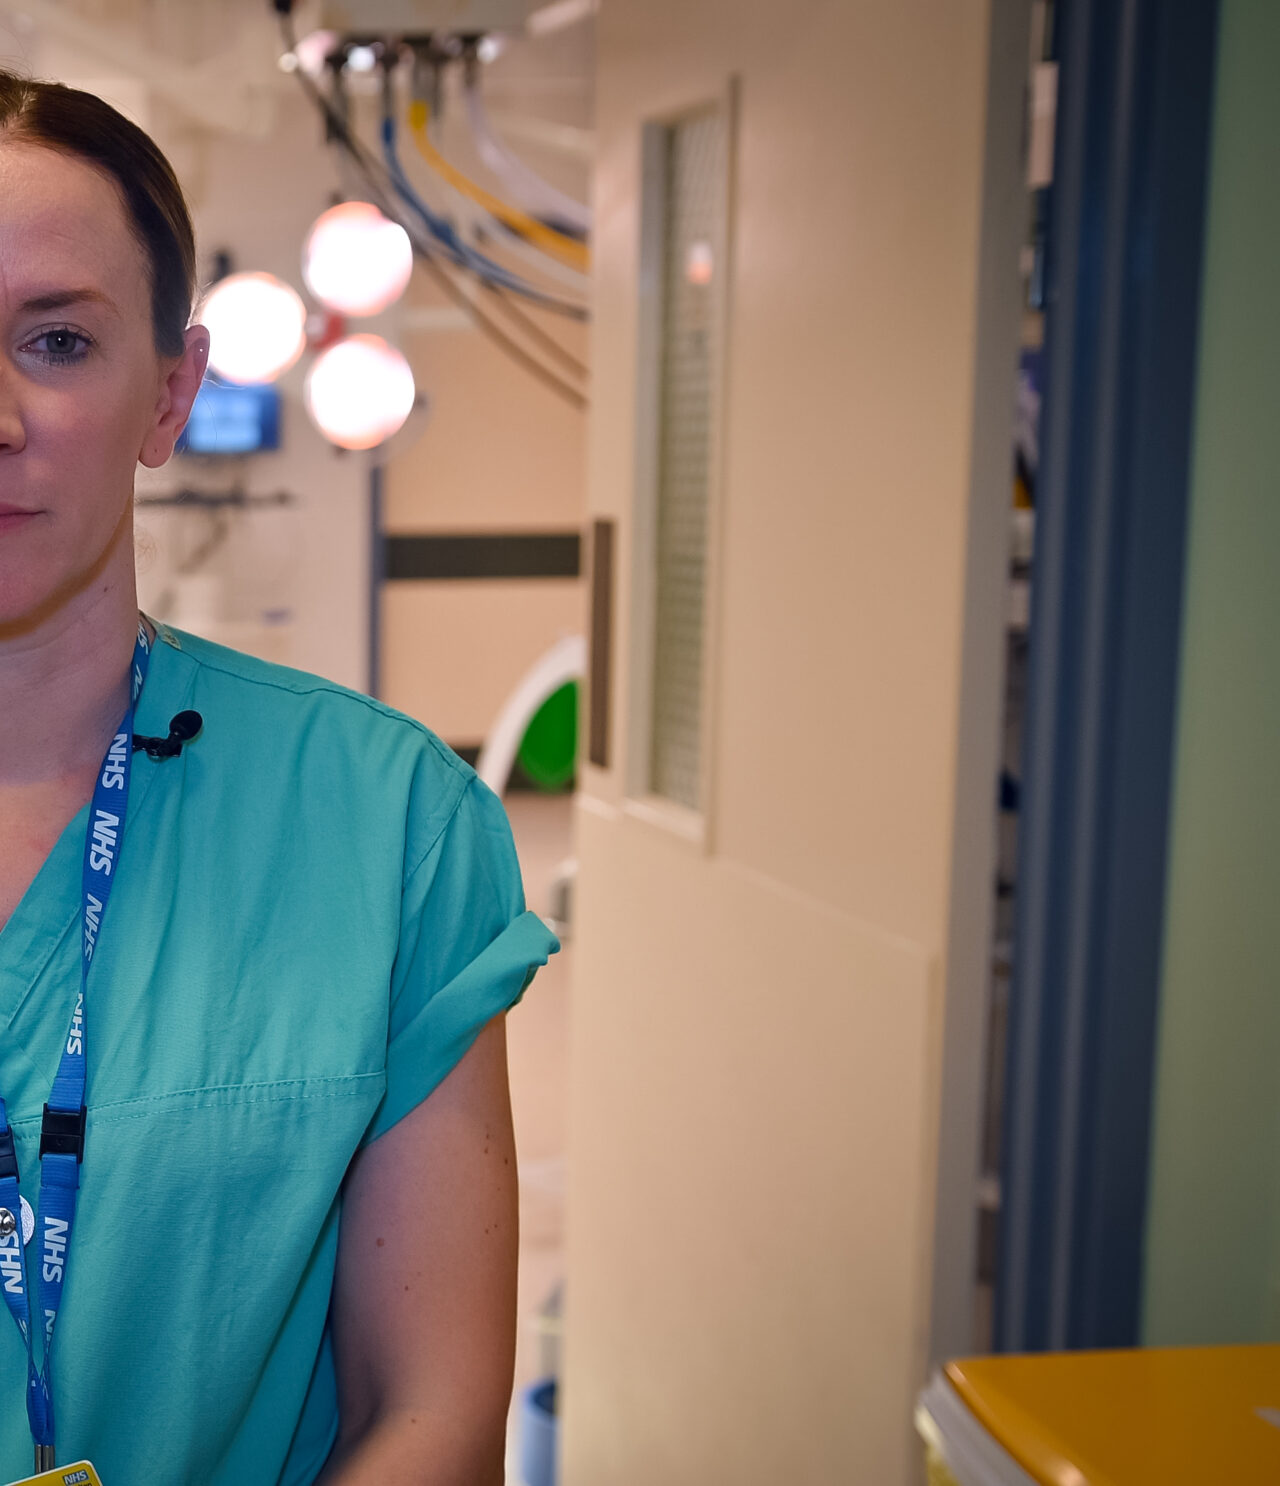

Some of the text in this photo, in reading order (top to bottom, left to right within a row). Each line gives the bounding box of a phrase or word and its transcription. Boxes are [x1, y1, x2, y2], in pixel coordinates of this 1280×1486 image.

[101, 733, 128, 790] NHS
[89, 809, 120, 876] NHS
[84, 893, 103, 962] NHS
[66, 992, 84, 1056] NHS
[42, 1216, 69, 1283] NHS
[63, 1470, 88, 1485] NHS
